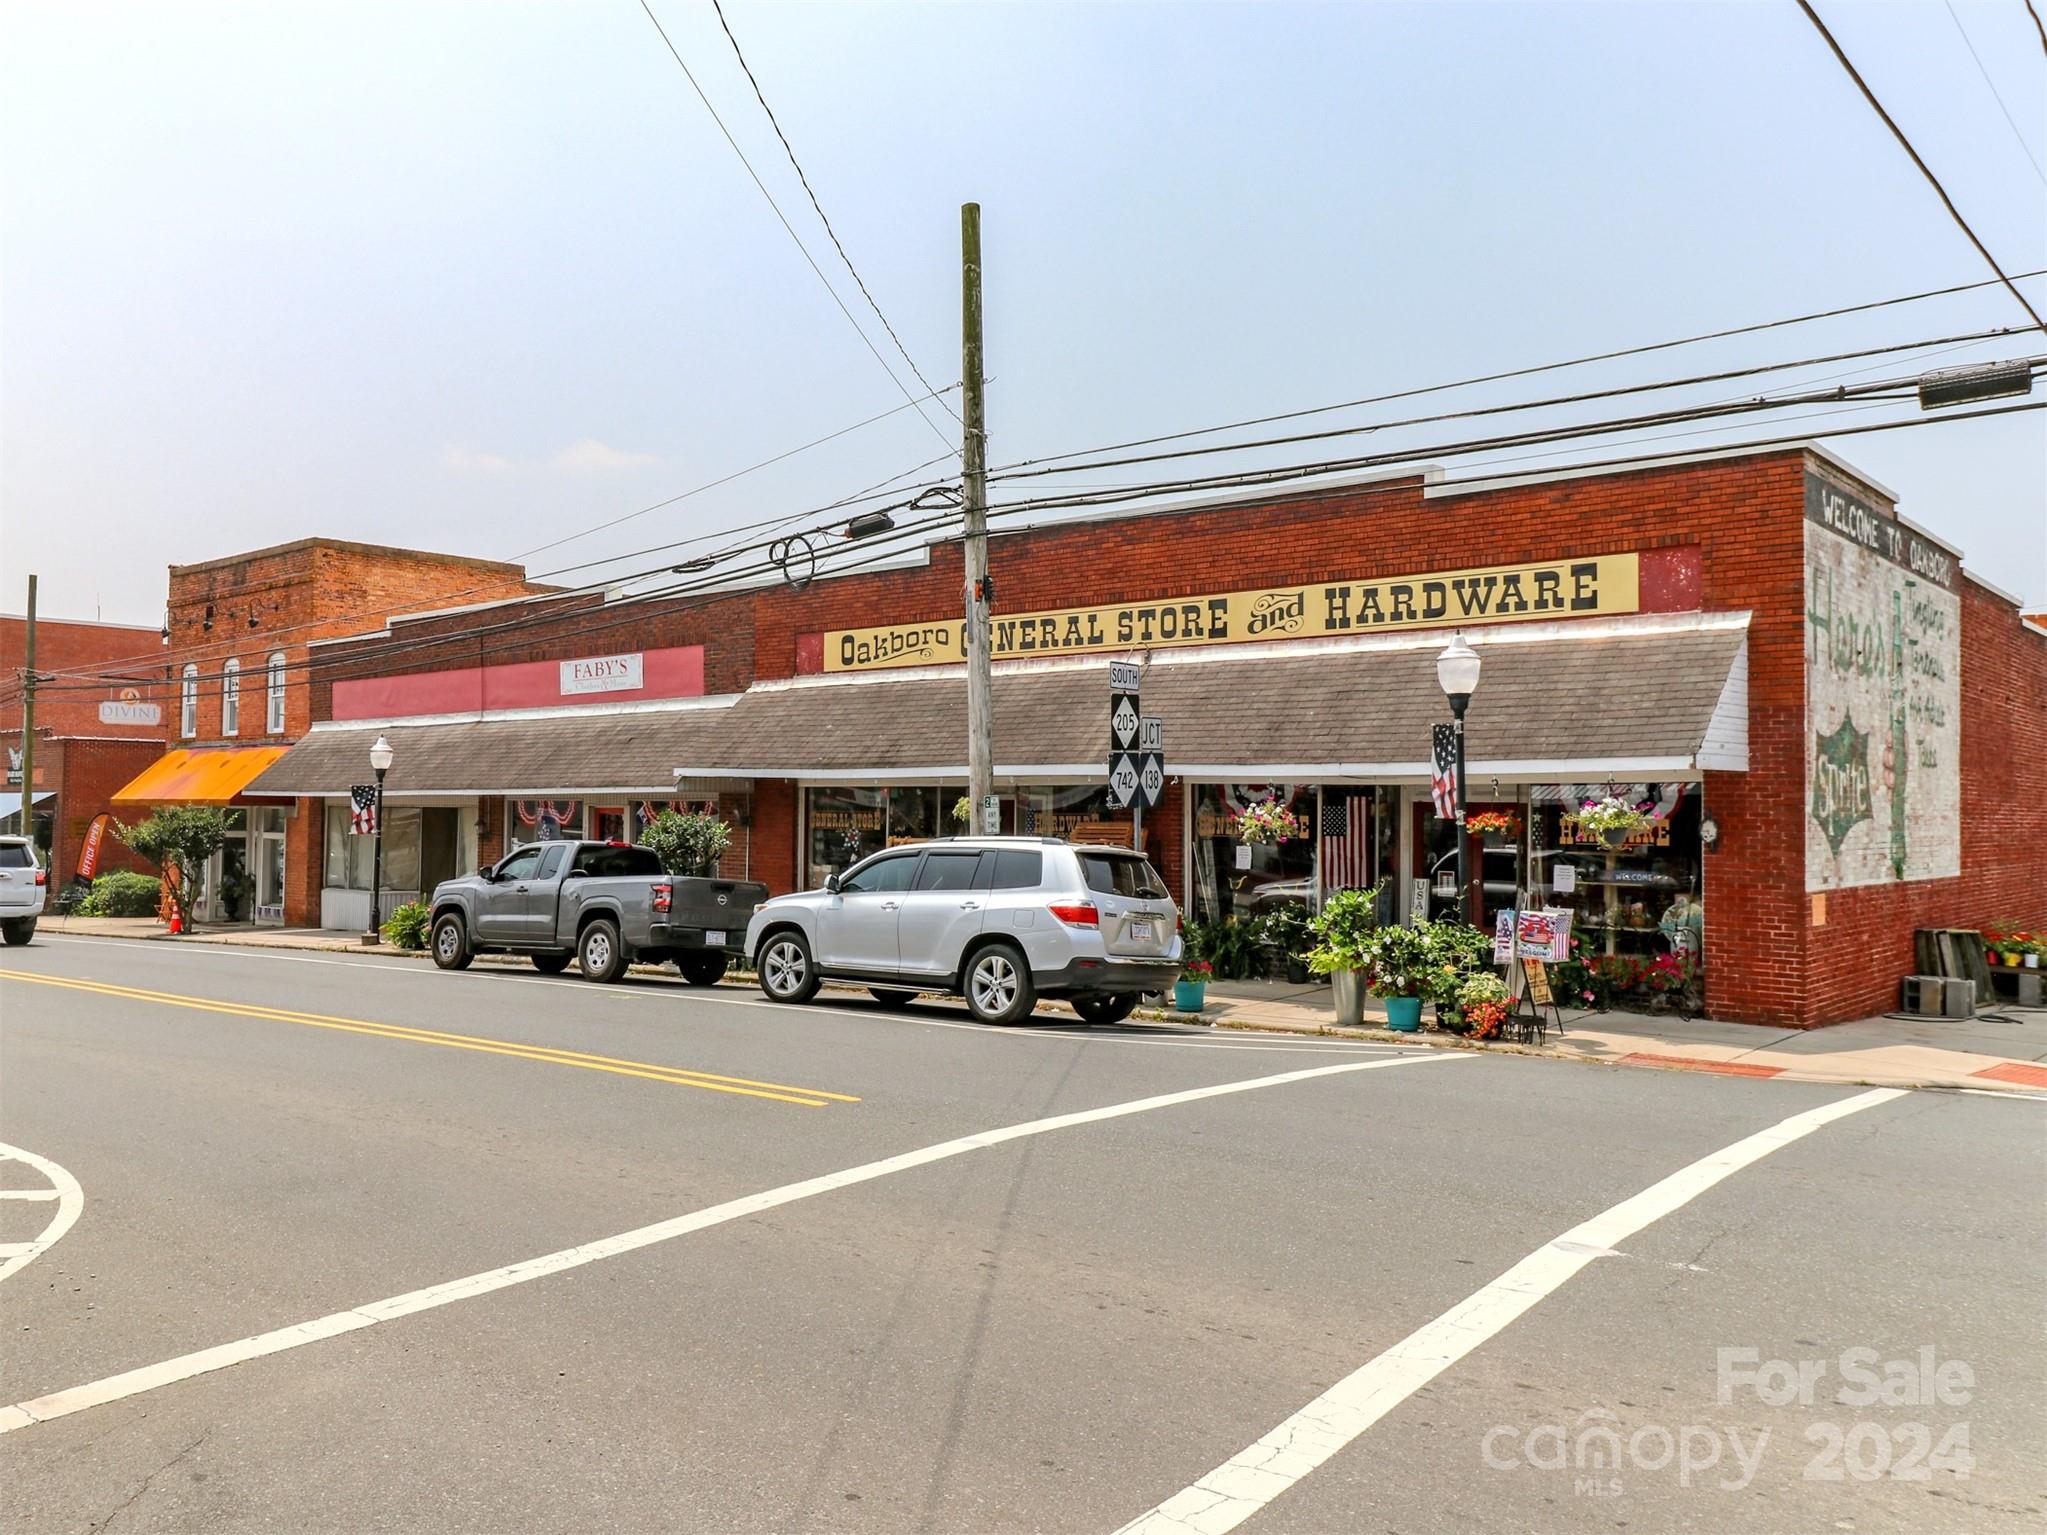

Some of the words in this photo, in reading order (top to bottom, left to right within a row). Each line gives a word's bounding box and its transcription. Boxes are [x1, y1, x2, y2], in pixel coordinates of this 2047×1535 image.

[1822, 489, 1880, 548] WELCOME
[1887, 526, 1903, 562] TO
[840, 627, 949, 667] Oakboro
[960, 613, 1104, 658] NERAL
[1117, 598, 1229, 643] STORE
[1247, 590, 1305, 635] and
[1324, 562, 1598, 631] HARDWARE
[574, 659, 629, 679] FABY'S
[1111, 667, 1138, 685] SOUTH
[1116, 713, 1135, 731] 205
[1142, 723, 1161, 745] JCT
[1116, 771, 1133, 790] 742
[1144, 770, 1159, 790] 138
[1816, 753, 1868, 836] Sprite
[1615, 872, 1654, 882] WELCOME
